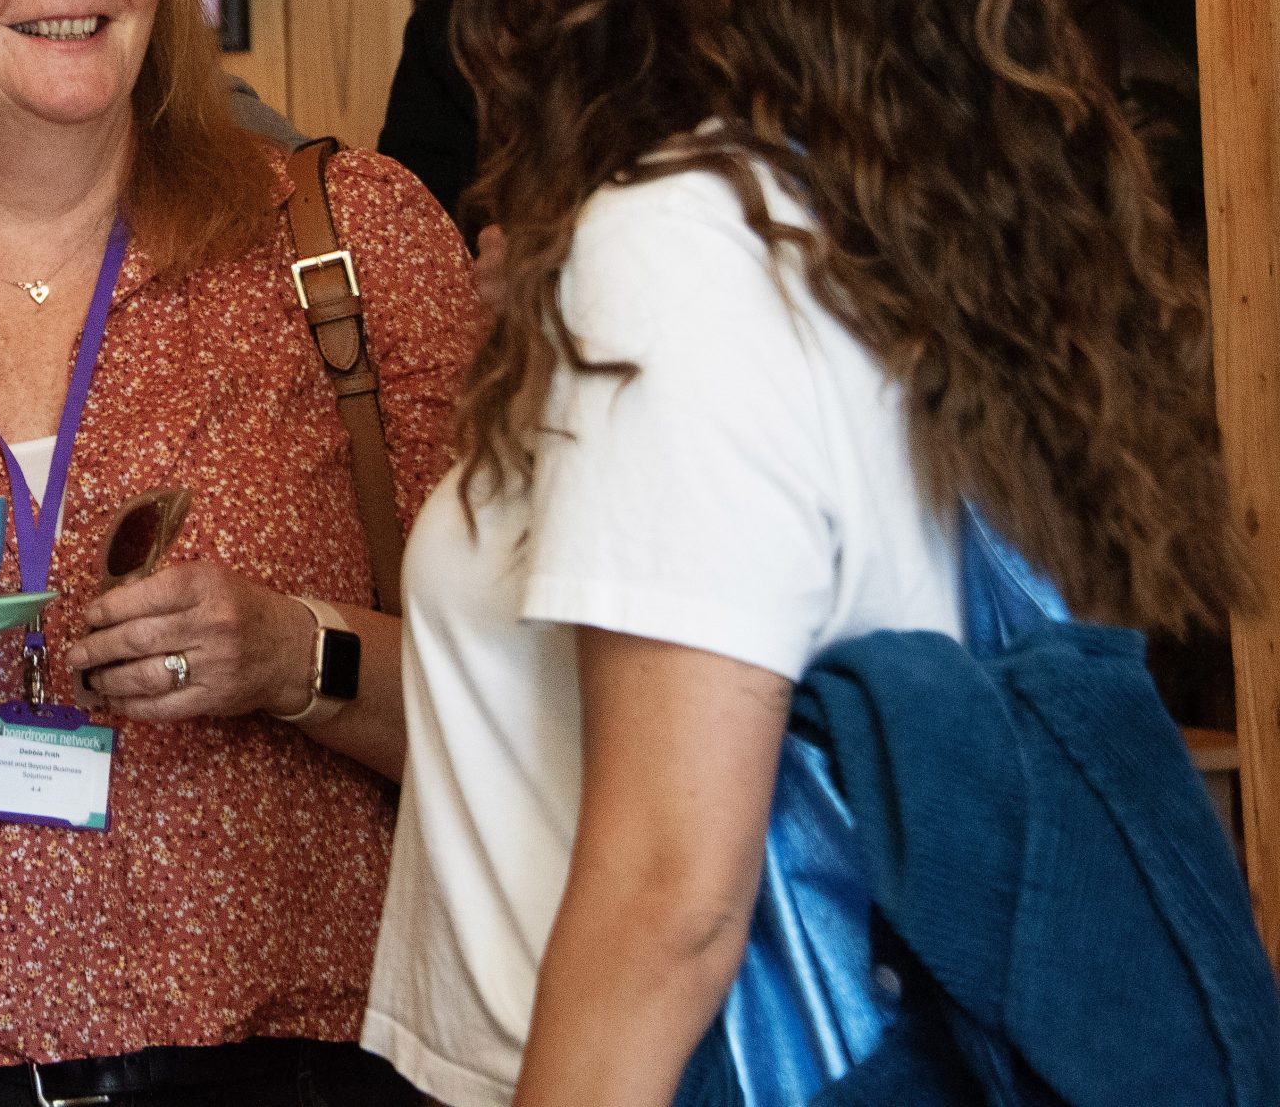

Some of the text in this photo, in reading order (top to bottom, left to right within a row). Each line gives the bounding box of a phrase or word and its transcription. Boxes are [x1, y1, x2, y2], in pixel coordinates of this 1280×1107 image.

[3, 726, 58, 744] boardroom
[60, 734, 101, 749] network
[14, 759, 28, 768] and
